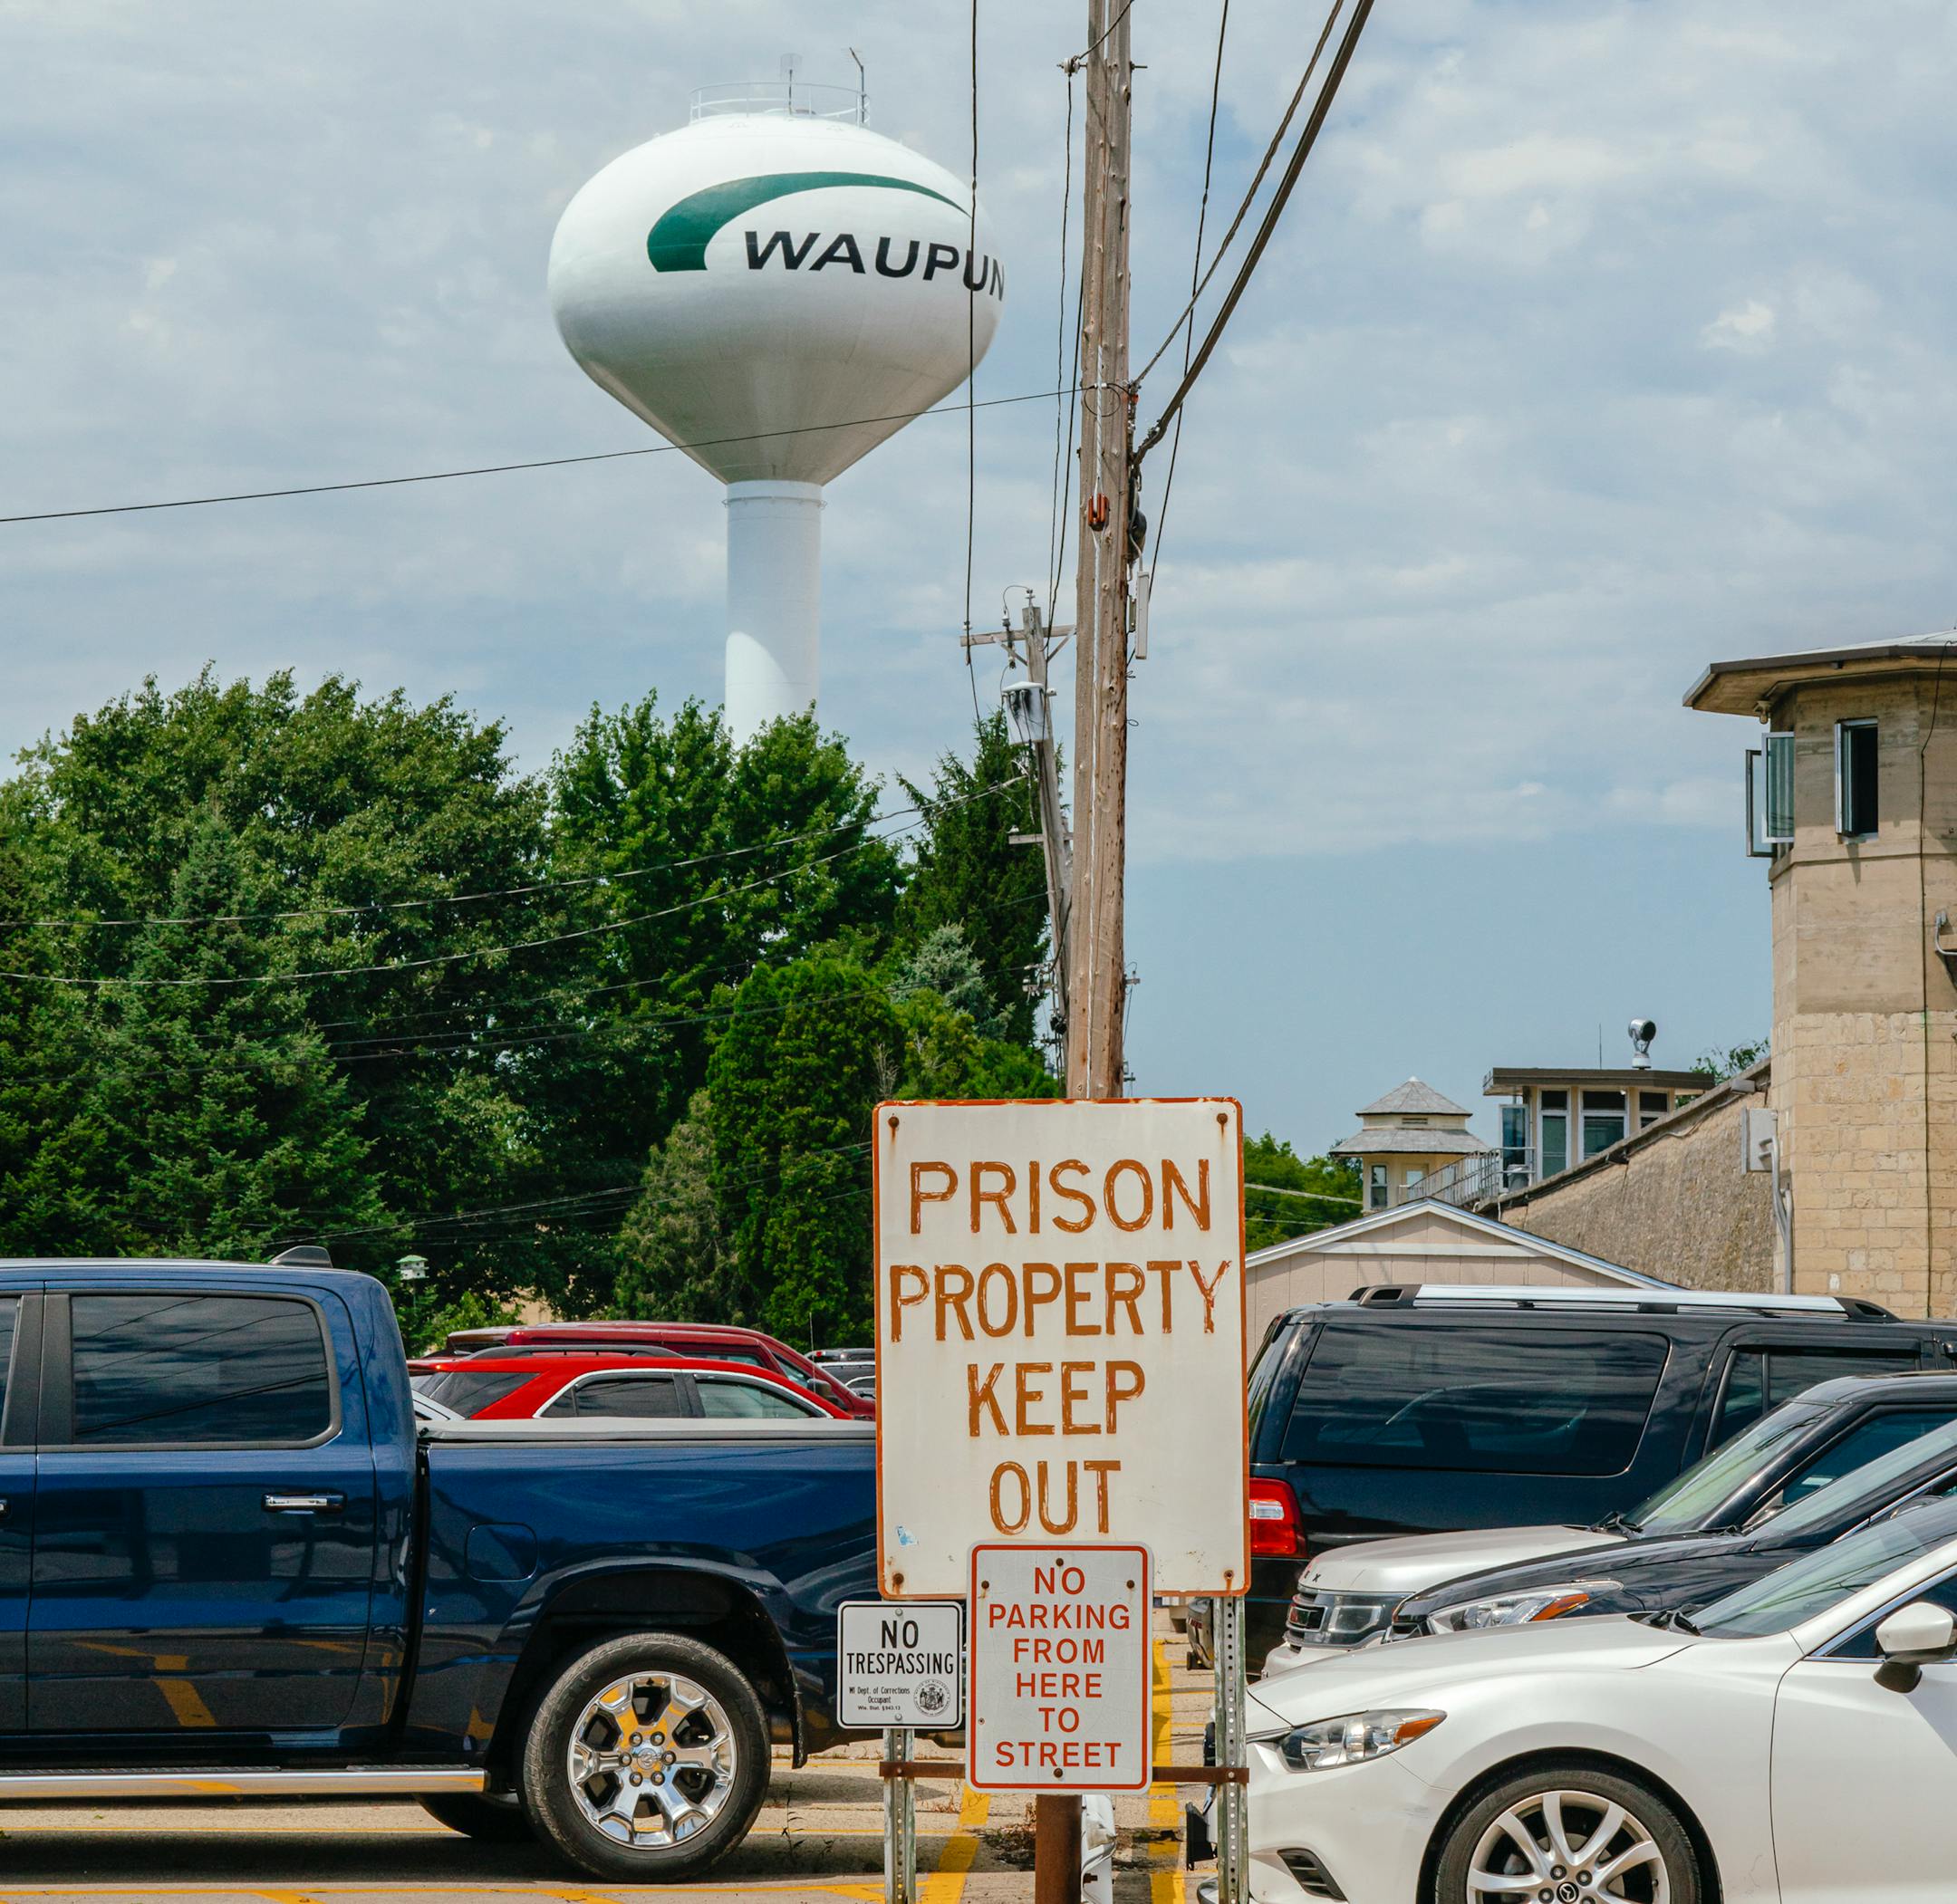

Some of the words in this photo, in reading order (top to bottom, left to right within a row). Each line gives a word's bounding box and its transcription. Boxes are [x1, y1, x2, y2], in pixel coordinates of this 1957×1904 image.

[745, 230, 1006, 302] WAUPUN
[909, 1159, 1211, 1236] PRISON
[889, 1259, 1233, 1343] PROPERTY
[967, 1360, 1146, 1438] KEEP
[988, 1459, 1122, 1536] OUT
[1034, 1566, 1085, 1596] NO
[988, 1603, 1131, 1630] PARKING
[881, 1620, 920, 1649] NO
[846, 1652, 954, 1675] TRESPASSING
[1013, 1638, 1104, 1665] FROM
[857, 1686, 871, 1697] Dept.
[872, 1687, 879, 1695] of
[881, 1686, 911, 1695] Corrections
[1016, 1672, 1103, 1698] HERE
[867, 1696, 892, 1705] Occupant
[1037, 1707, 1080, 1733] TO
[995, 1741, 1123, 1768] STREET
